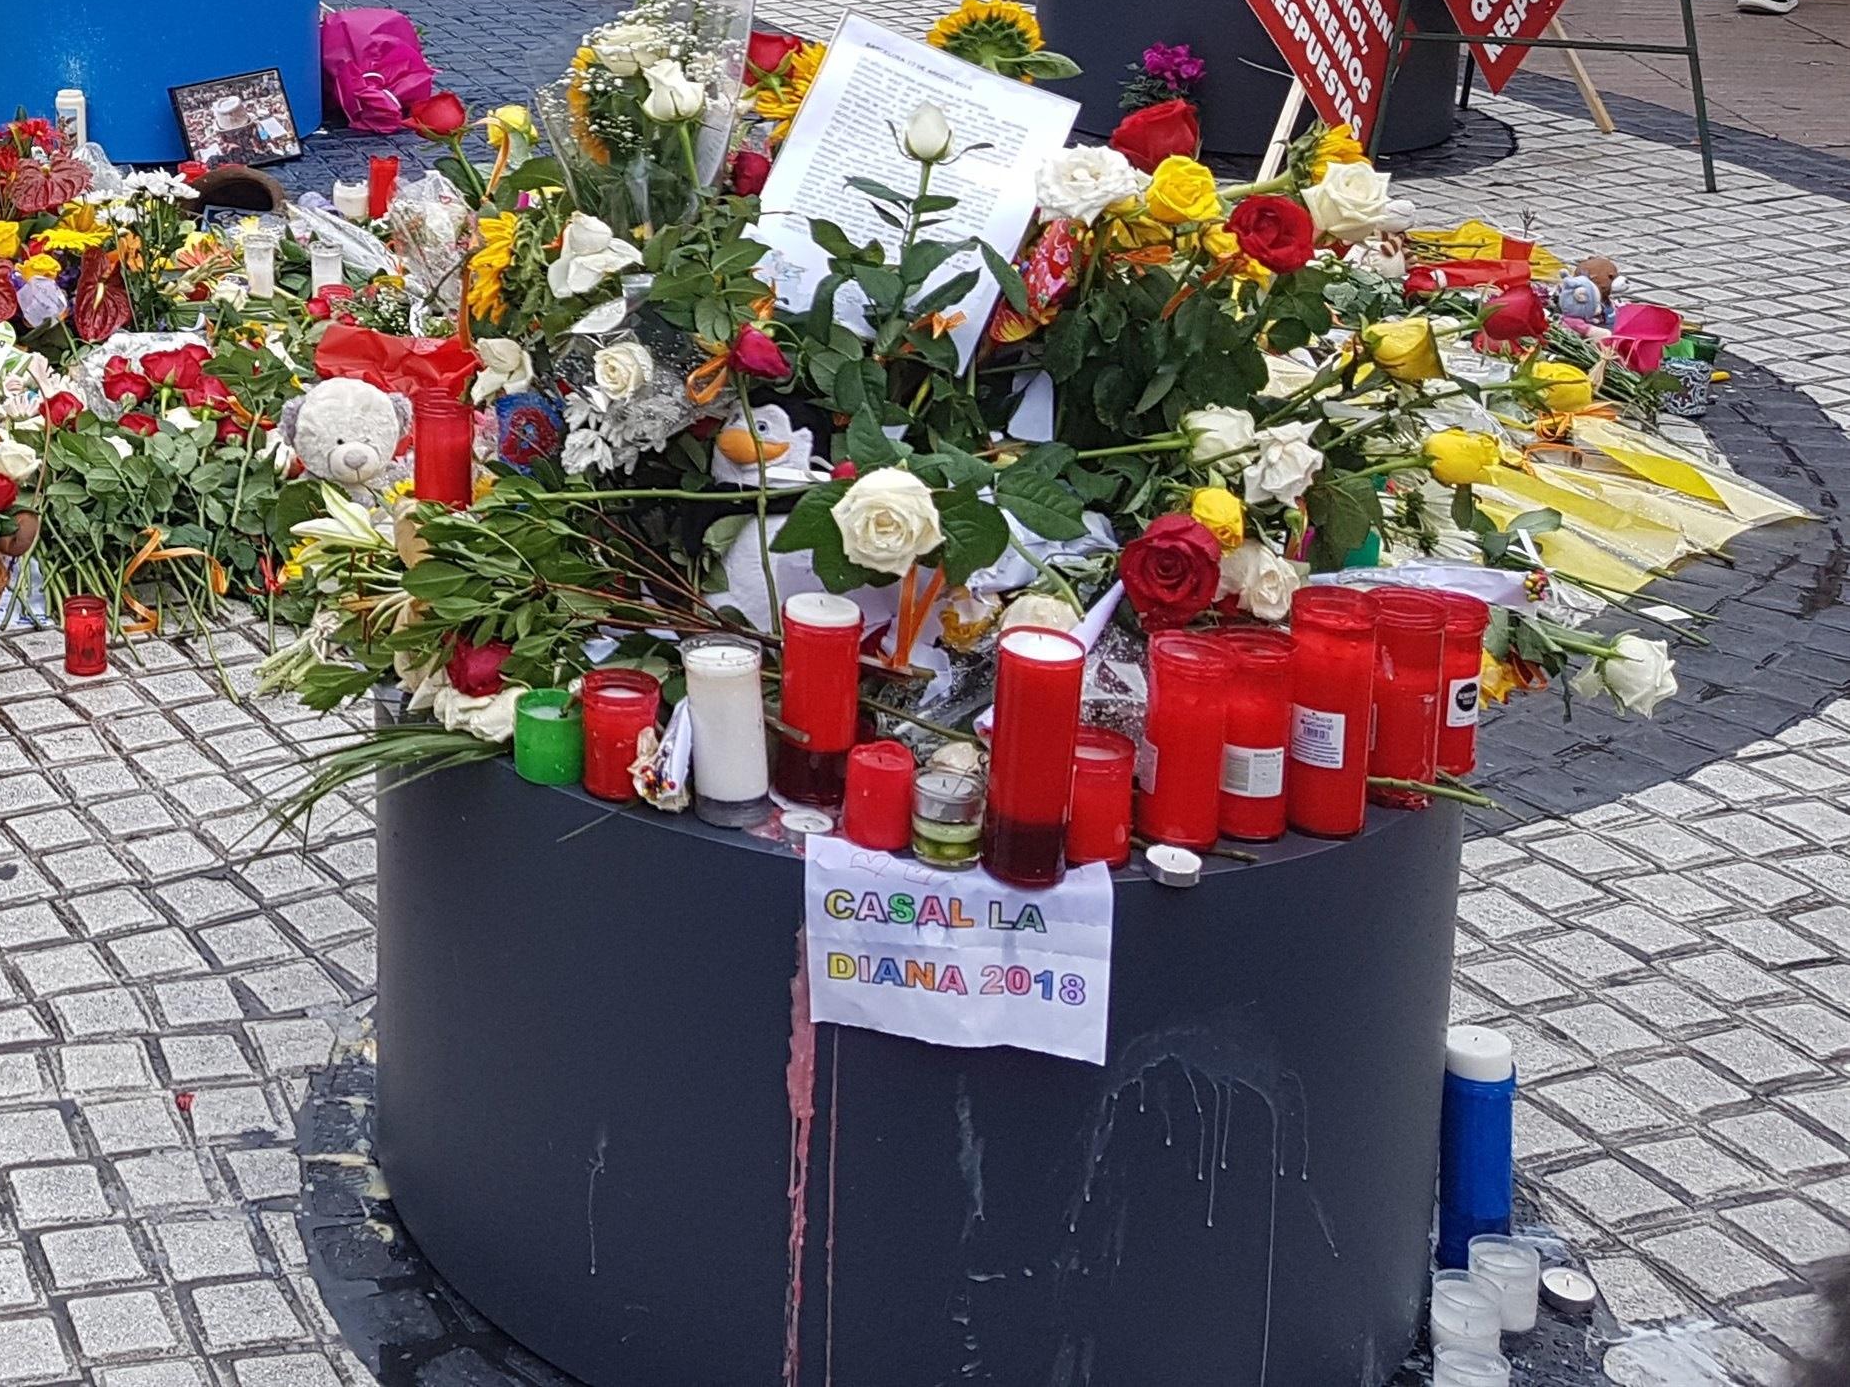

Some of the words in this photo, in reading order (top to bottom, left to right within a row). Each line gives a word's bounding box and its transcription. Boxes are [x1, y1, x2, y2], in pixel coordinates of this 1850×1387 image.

[824, 889, 975, 928] CASAL
[988, 900, 1047, 934] LA
[827, 952, 968, 996] DIANA
[979, 964, 1087, 1007] 2018
